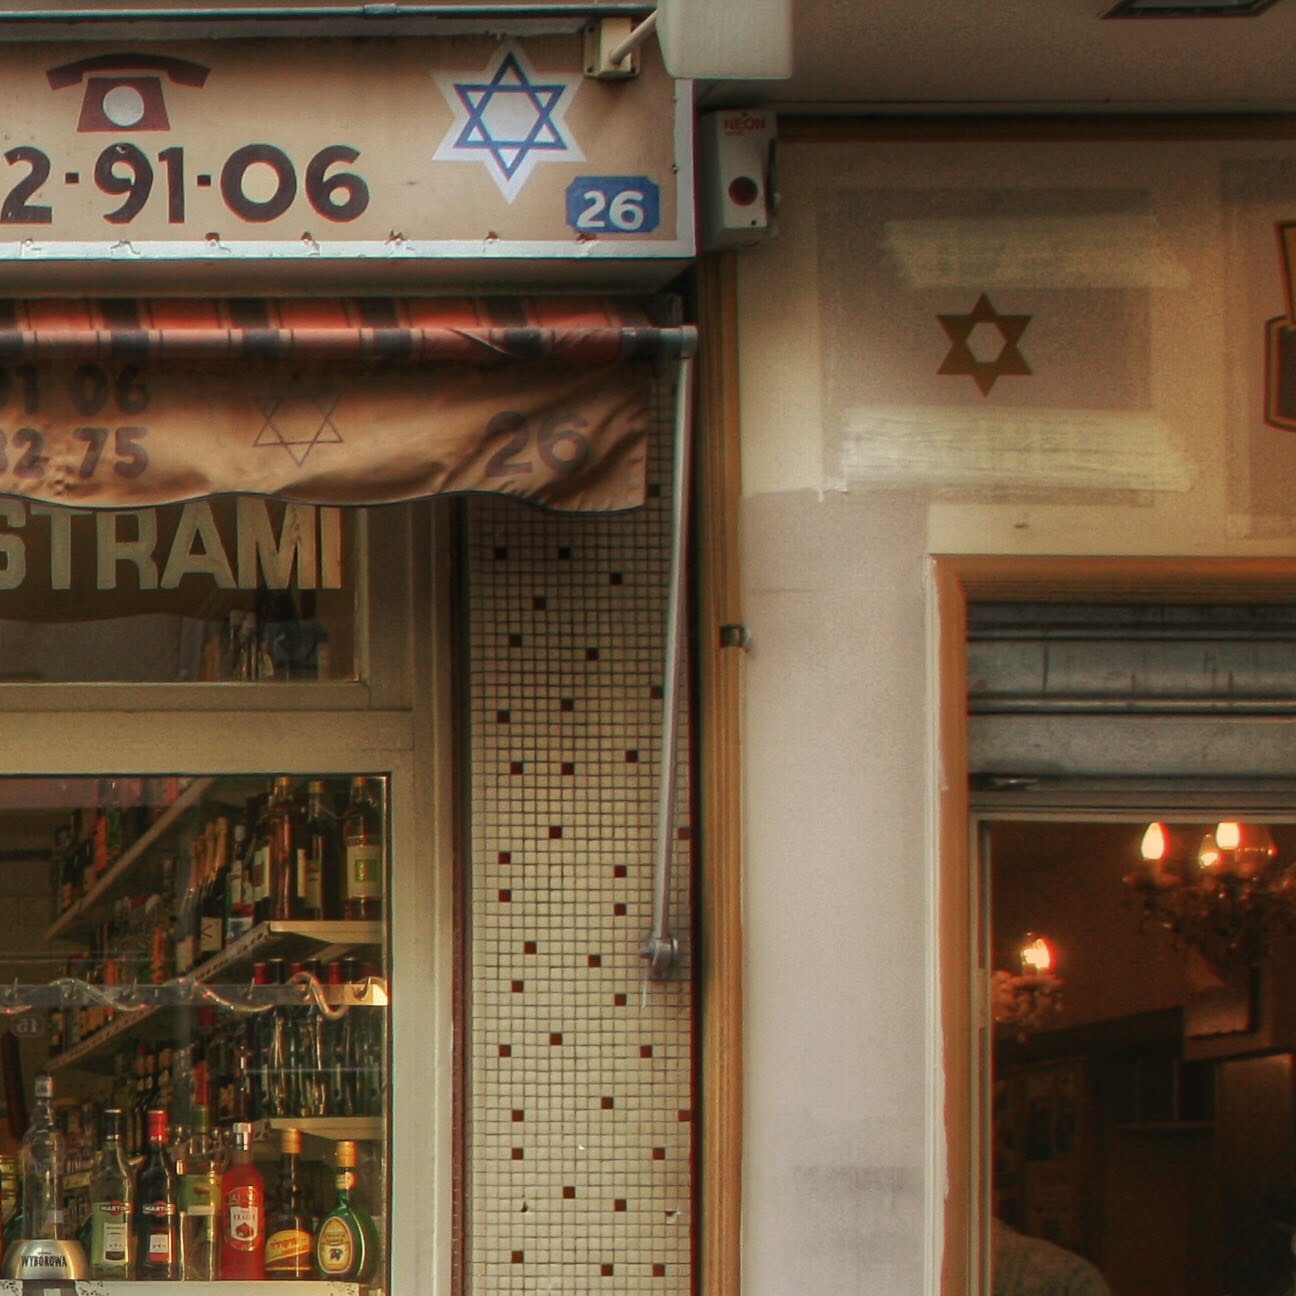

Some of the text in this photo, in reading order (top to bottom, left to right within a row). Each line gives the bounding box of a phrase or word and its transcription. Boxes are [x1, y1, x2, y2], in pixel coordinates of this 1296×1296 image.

[576, 191, 646, 231] 26
[73, 427, 149, 480] 75
[485, 410, 592, 478] 26
